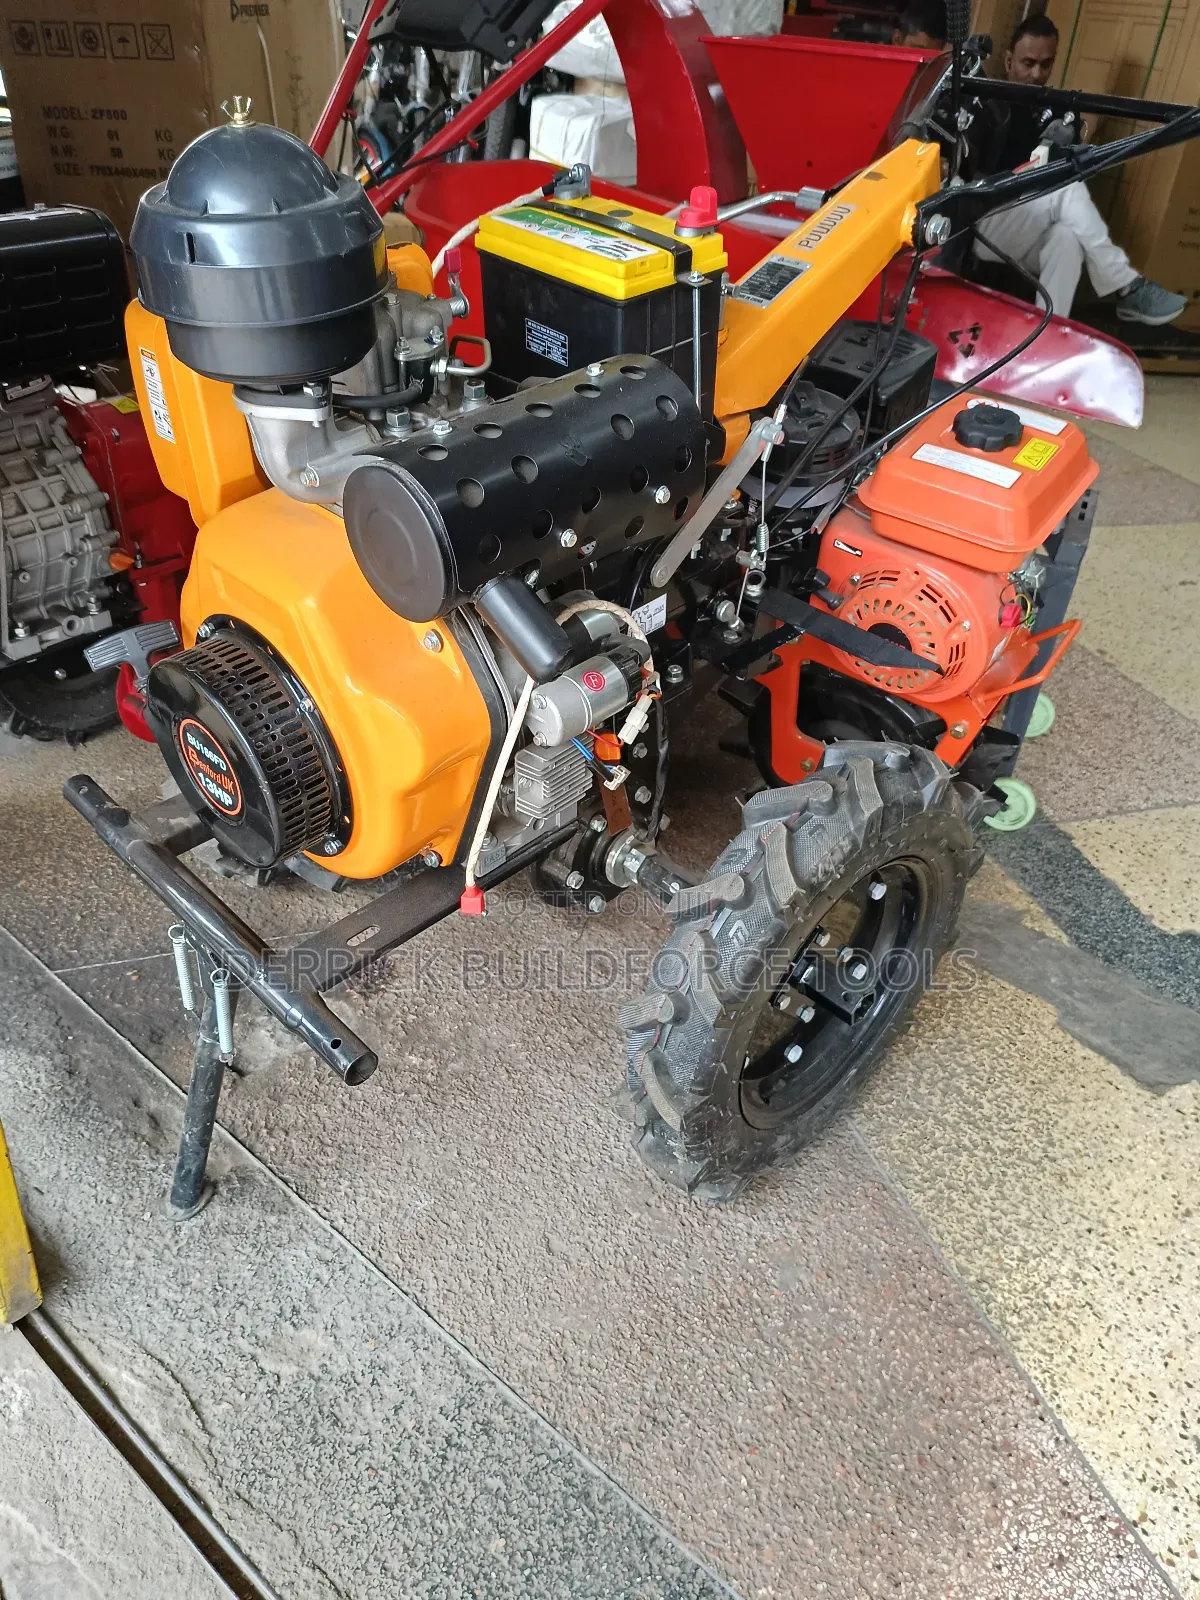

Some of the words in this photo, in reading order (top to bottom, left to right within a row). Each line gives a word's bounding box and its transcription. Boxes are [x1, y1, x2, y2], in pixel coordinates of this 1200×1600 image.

[41, 105, 90, 121] MODEL:
[154, 129, 173, 143] KG
[158, 148, 176, 161] KG
[187, 745, 221, 783] Benford
[220, 773, 235, 796] UK
[198, 772, 233, 807] 13HP
